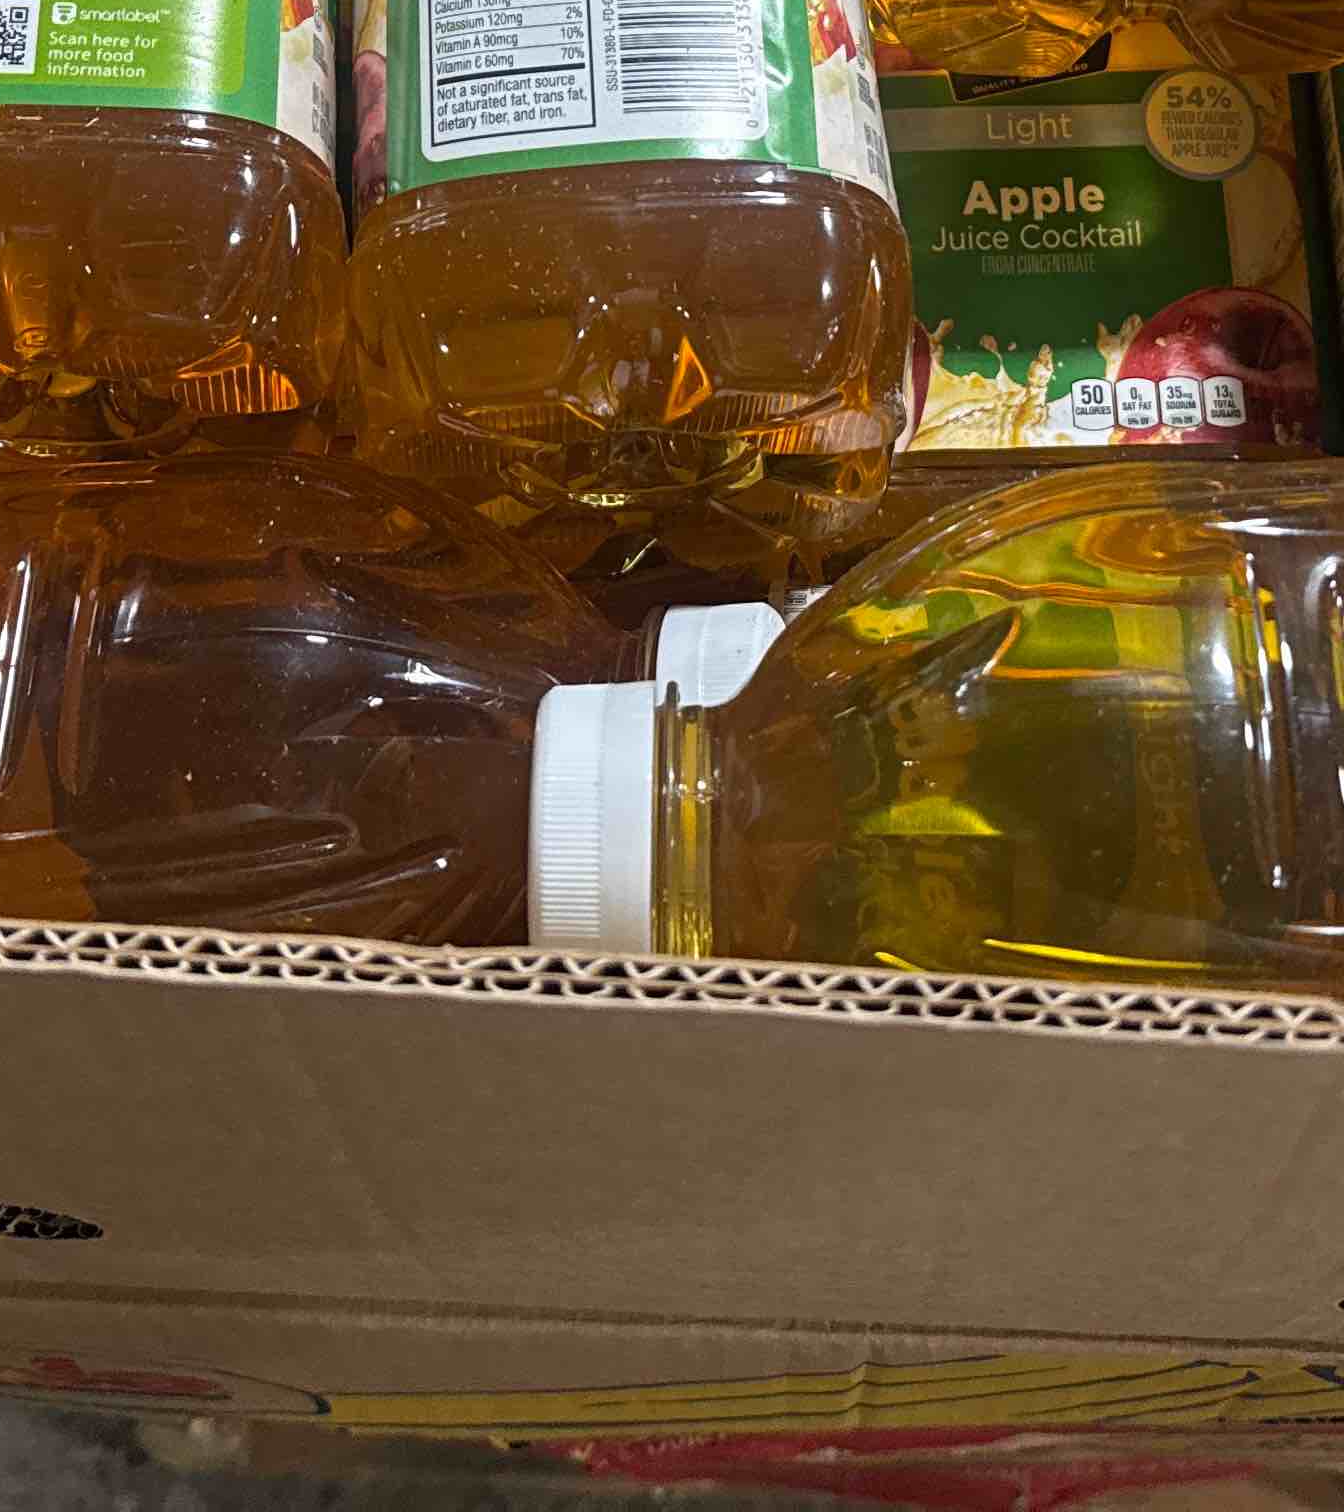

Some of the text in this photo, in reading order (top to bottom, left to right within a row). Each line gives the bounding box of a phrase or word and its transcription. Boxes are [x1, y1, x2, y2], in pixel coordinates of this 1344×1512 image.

[49, 32, 157, 49] Scan here for
[49, 48, 134, 62] more food
[48, 63, 145, 78] information
[1167, 86, 1232, 109] 54%
[986, 112, 1074, 144] Light
[962, 177, 1105, 221] Apple
[931, 221, 1142, 252] Juice Cocktail
[1081, 385, 1103, 406] 50
